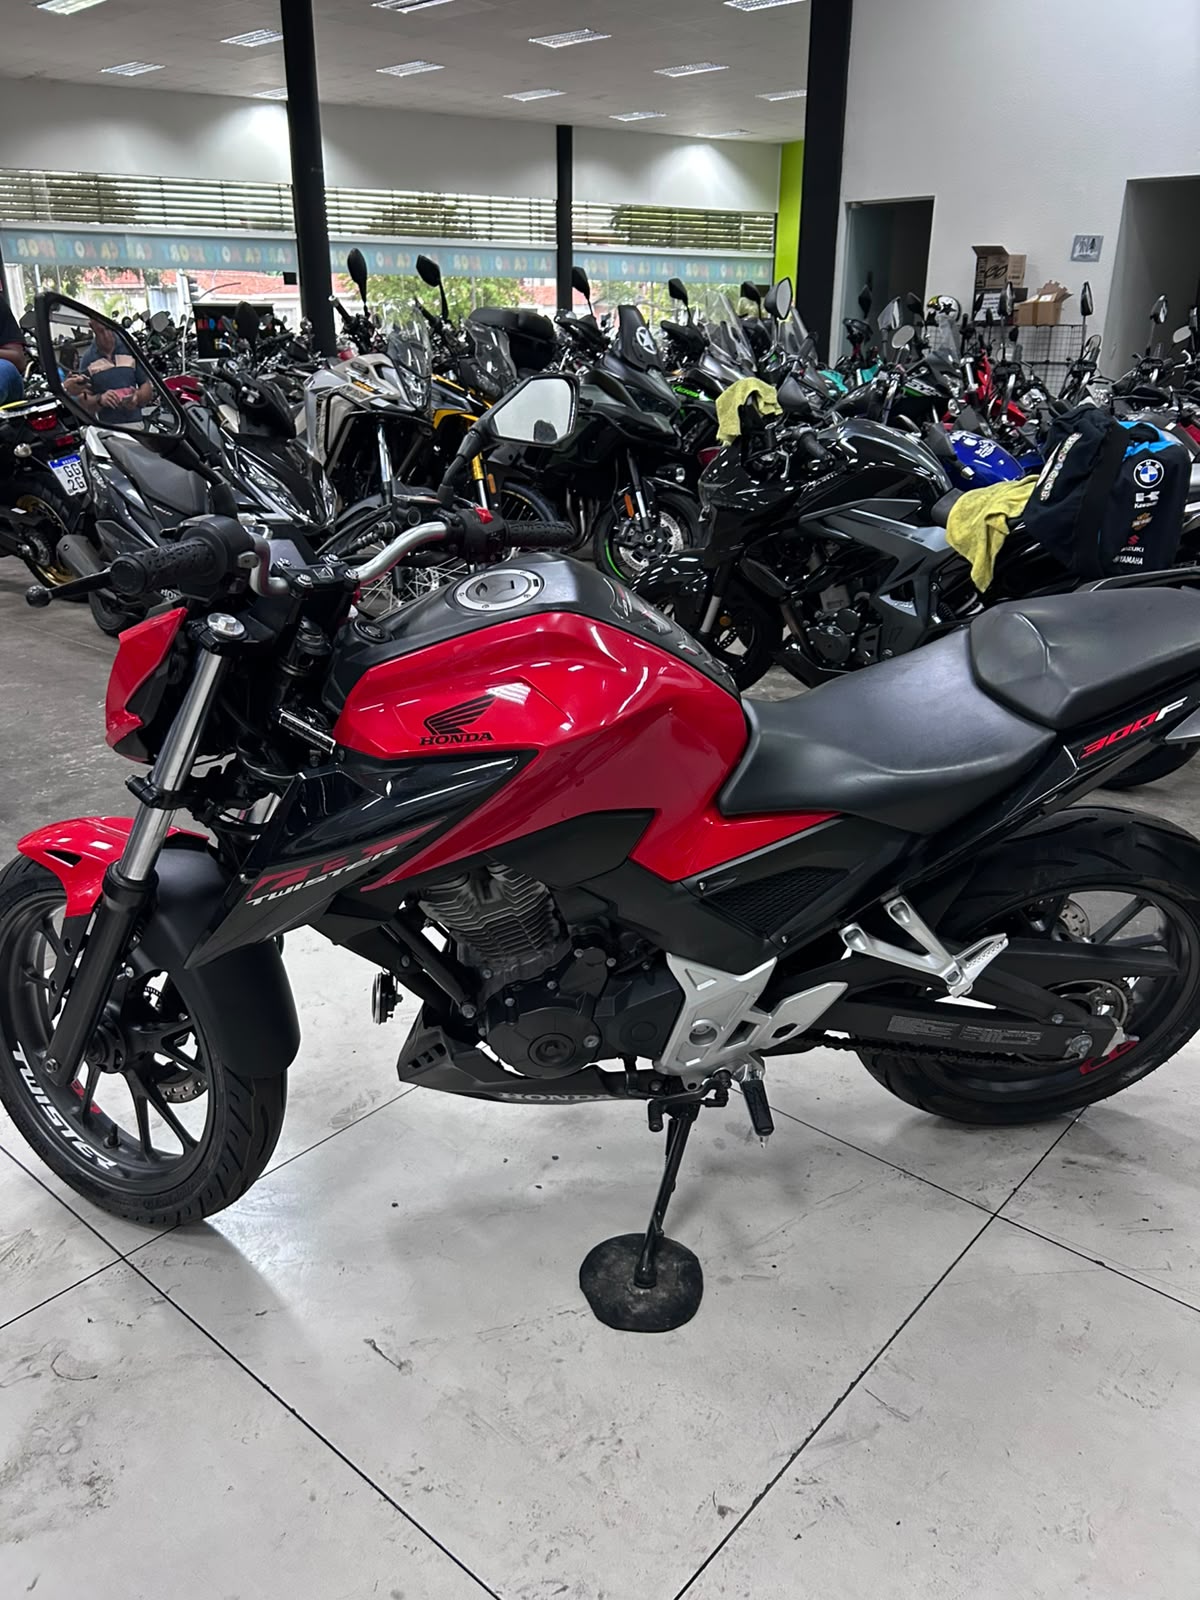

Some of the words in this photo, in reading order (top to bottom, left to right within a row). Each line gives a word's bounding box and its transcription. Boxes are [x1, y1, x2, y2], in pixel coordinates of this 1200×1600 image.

[1119, 555, 1144, 565] YAMAHA
[419, 731, 496, 747] HONDA
[1079, 696, 1188, 760] 300F
[245, 845, 399, 907] TWISTER
[12, 1040, 118, 1170] TWISTER
[500, 1092, 618, 1101] HONDA
